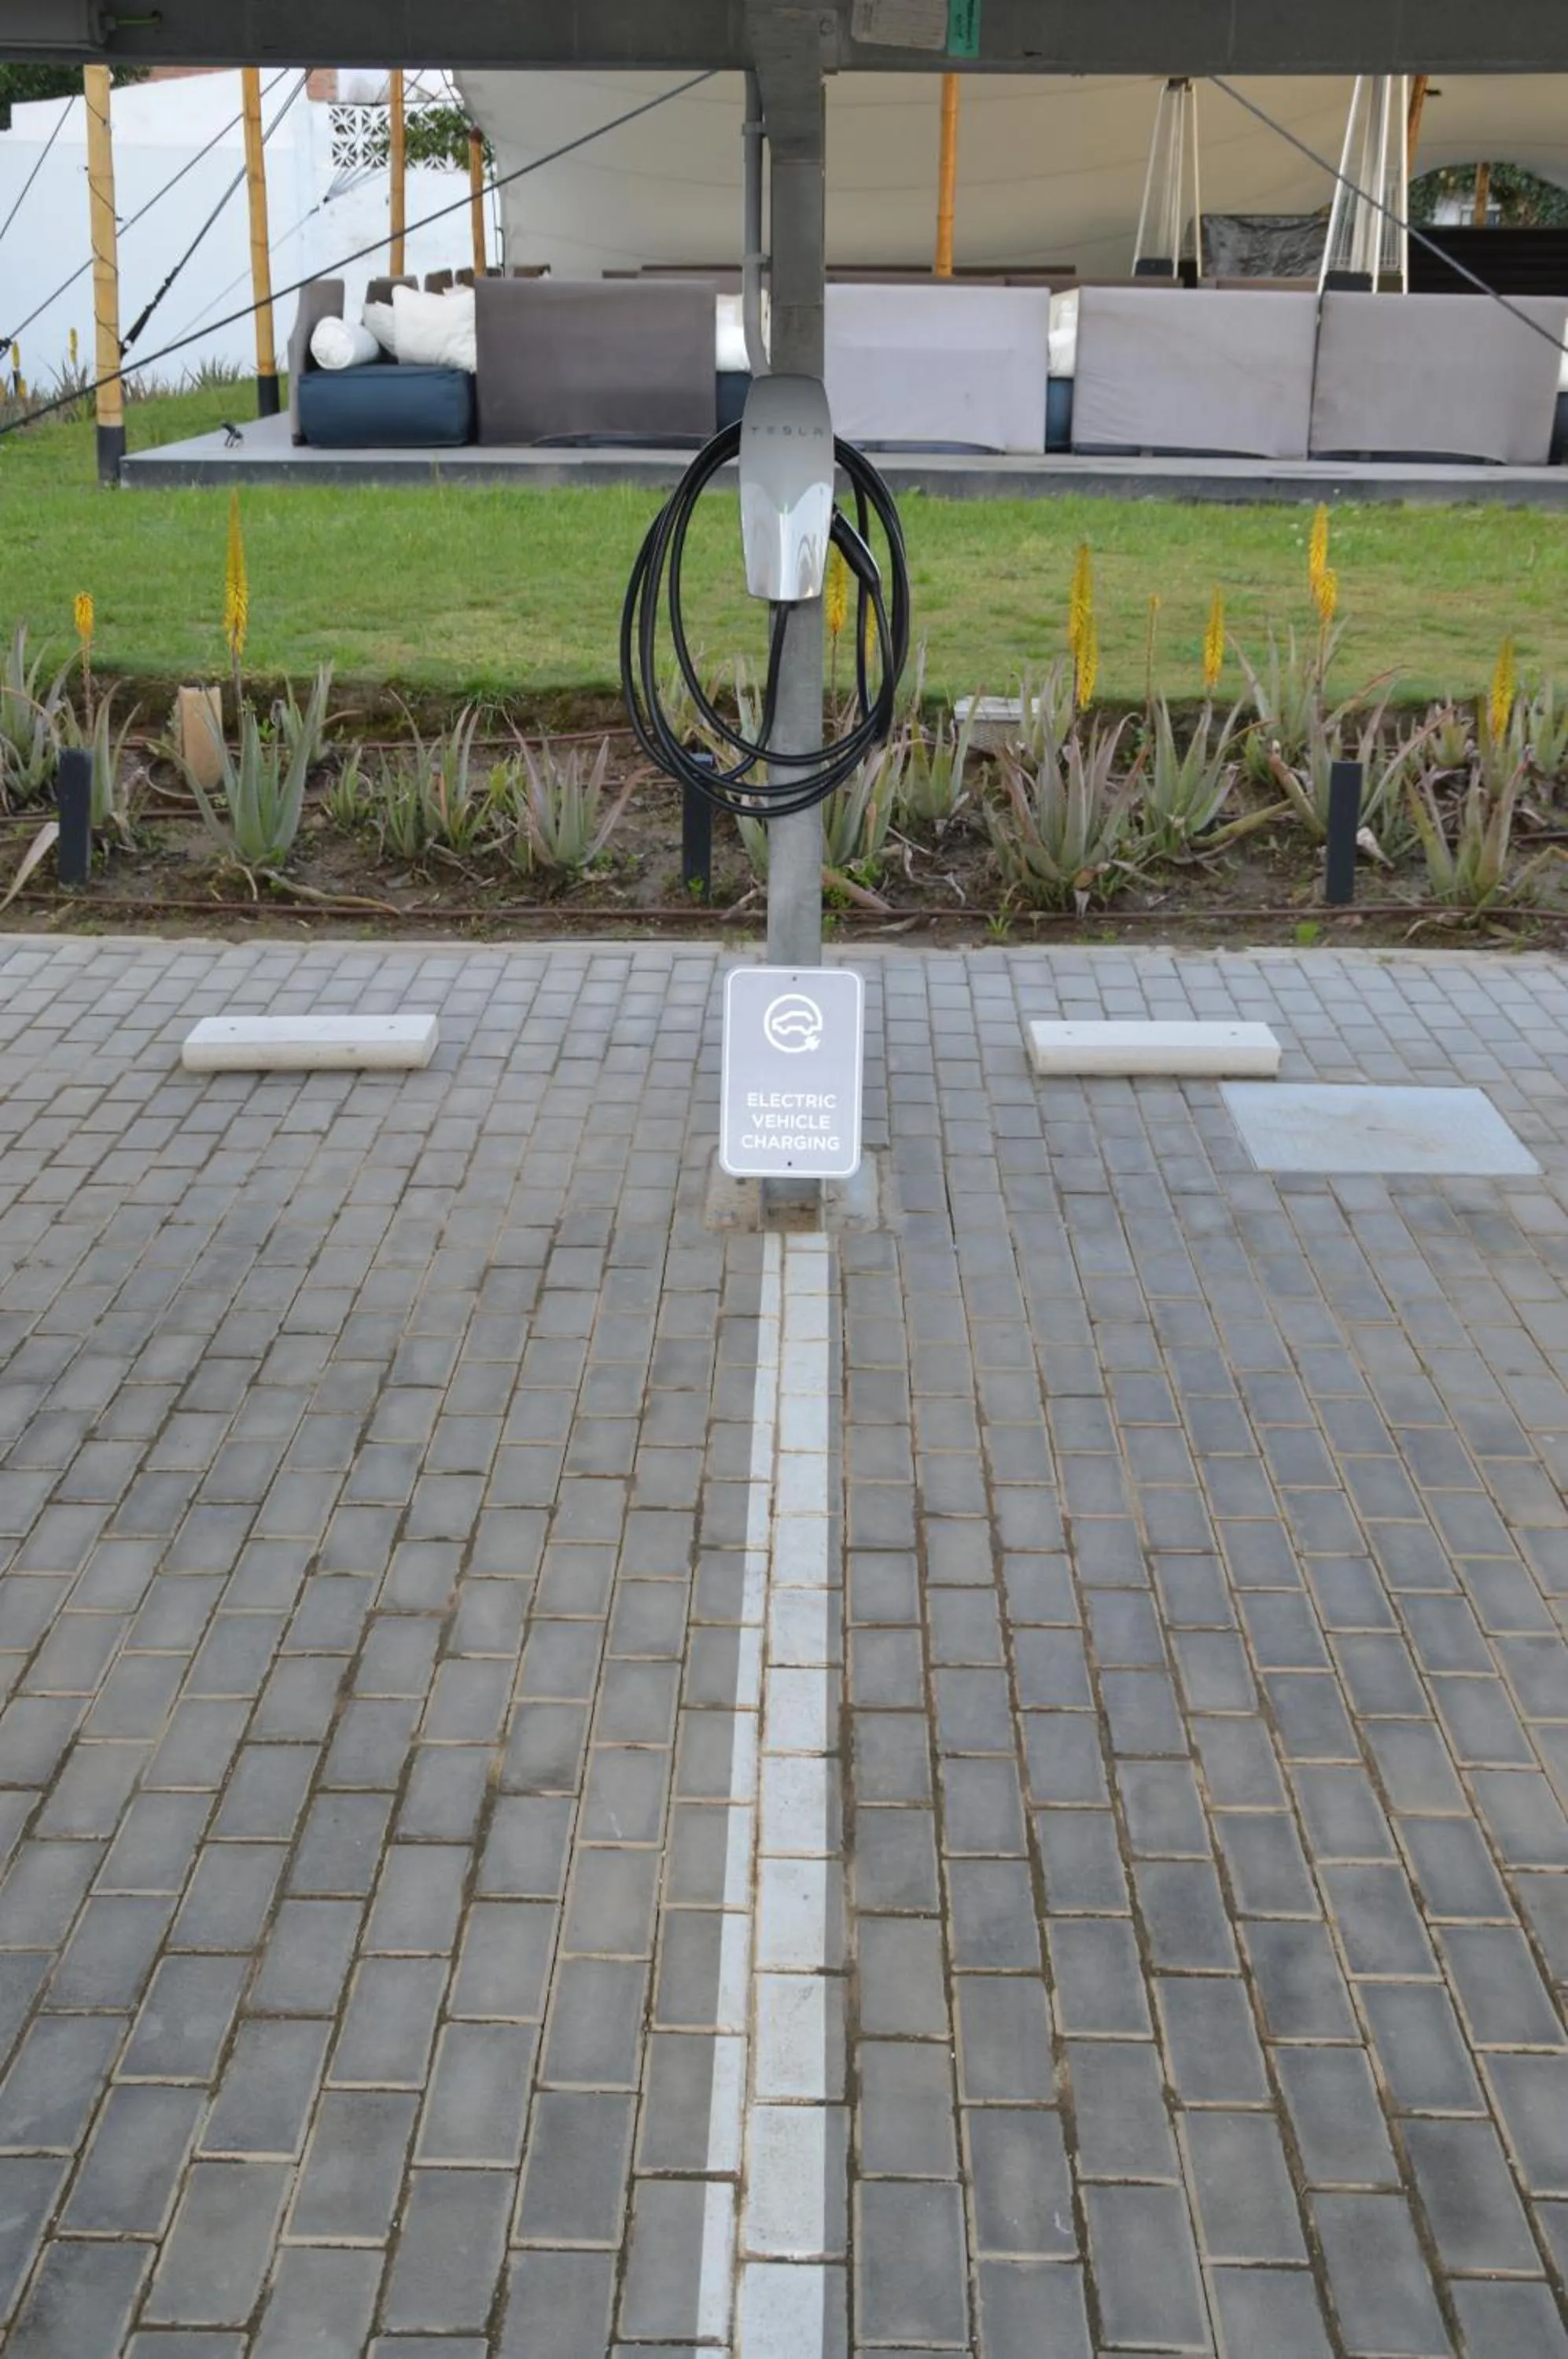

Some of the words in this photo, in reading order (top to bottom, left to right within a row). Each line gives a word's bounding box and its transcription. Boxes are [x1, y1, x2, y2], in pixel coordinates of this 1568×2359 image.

[746, 1093, 836, 1108] ELECTRIC
[753, 1114, 830, 1129] VEHICLE
[742, 1135, 840, 1150] CHARGING
